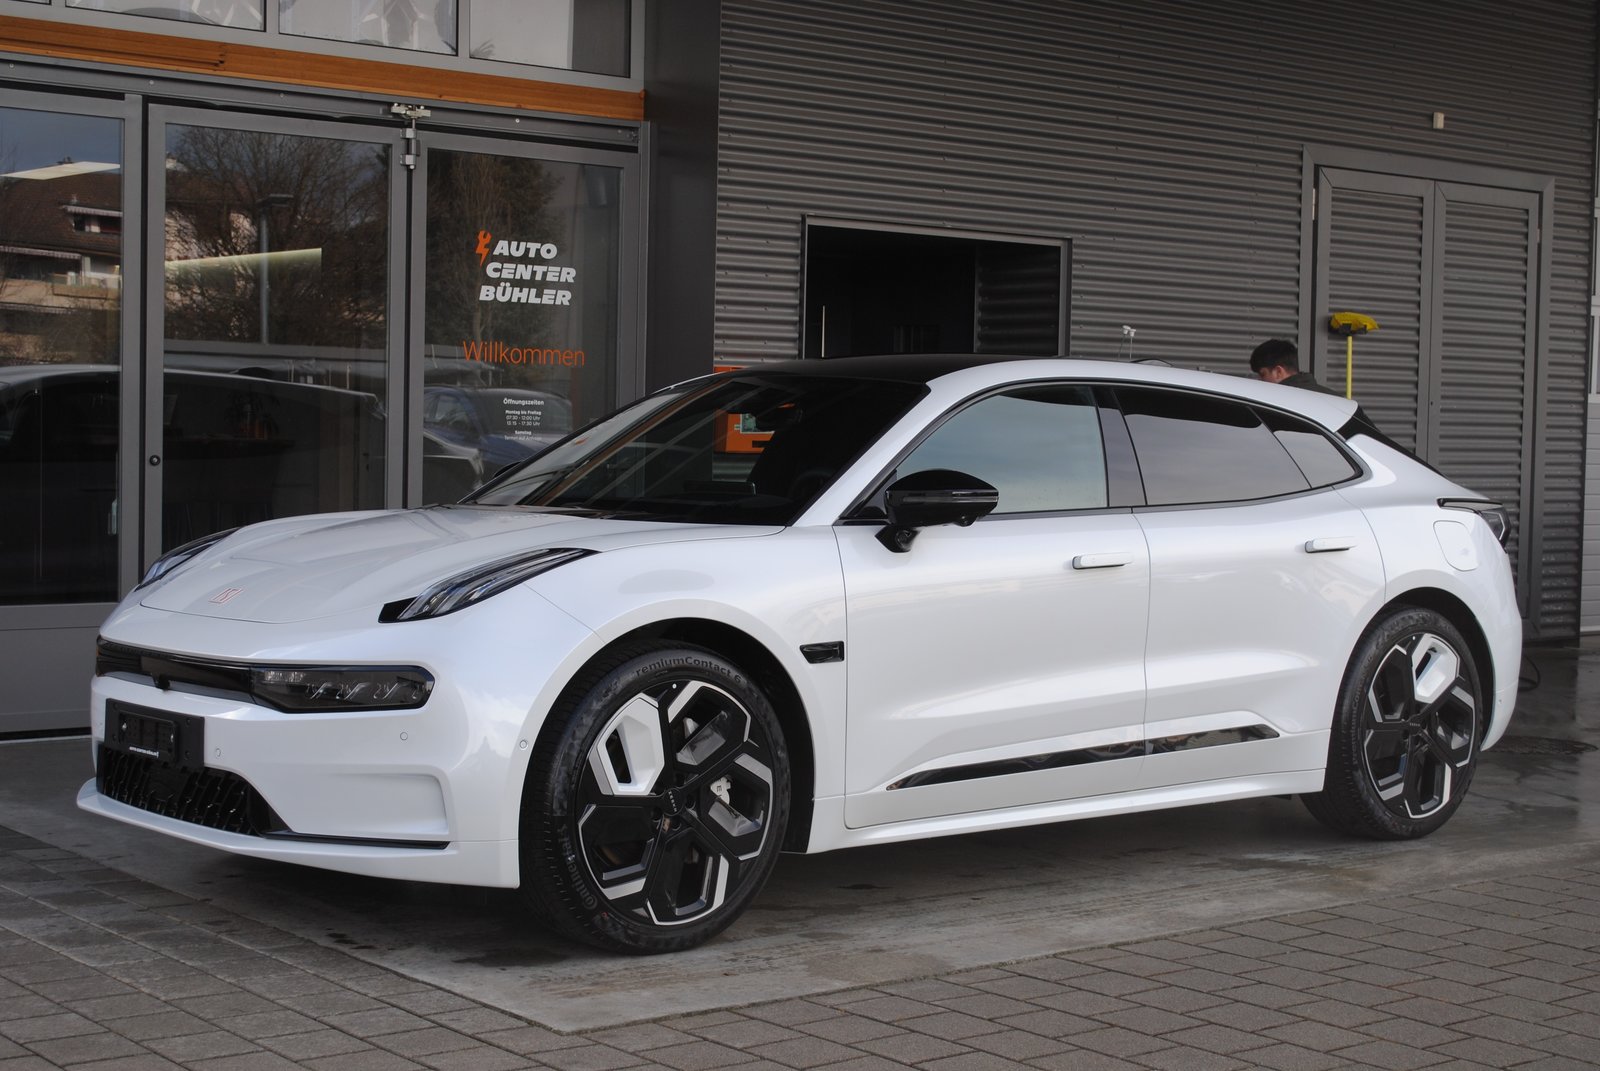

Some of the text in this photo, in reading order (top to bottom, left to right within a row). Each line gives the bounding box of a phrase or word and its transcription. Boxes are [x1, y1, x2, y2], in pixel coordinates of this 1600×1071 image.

[492, 240, 558, 260] AUTO
[485, 261, 577, 283] CENTER
[478, 281, 572, 306] BÜHLER
[462, 340, 586, 367] Willkommen
[503, 397, 544, 405] Öffnungszeiten
[631, 656, 742, 684] remiumContact 6
